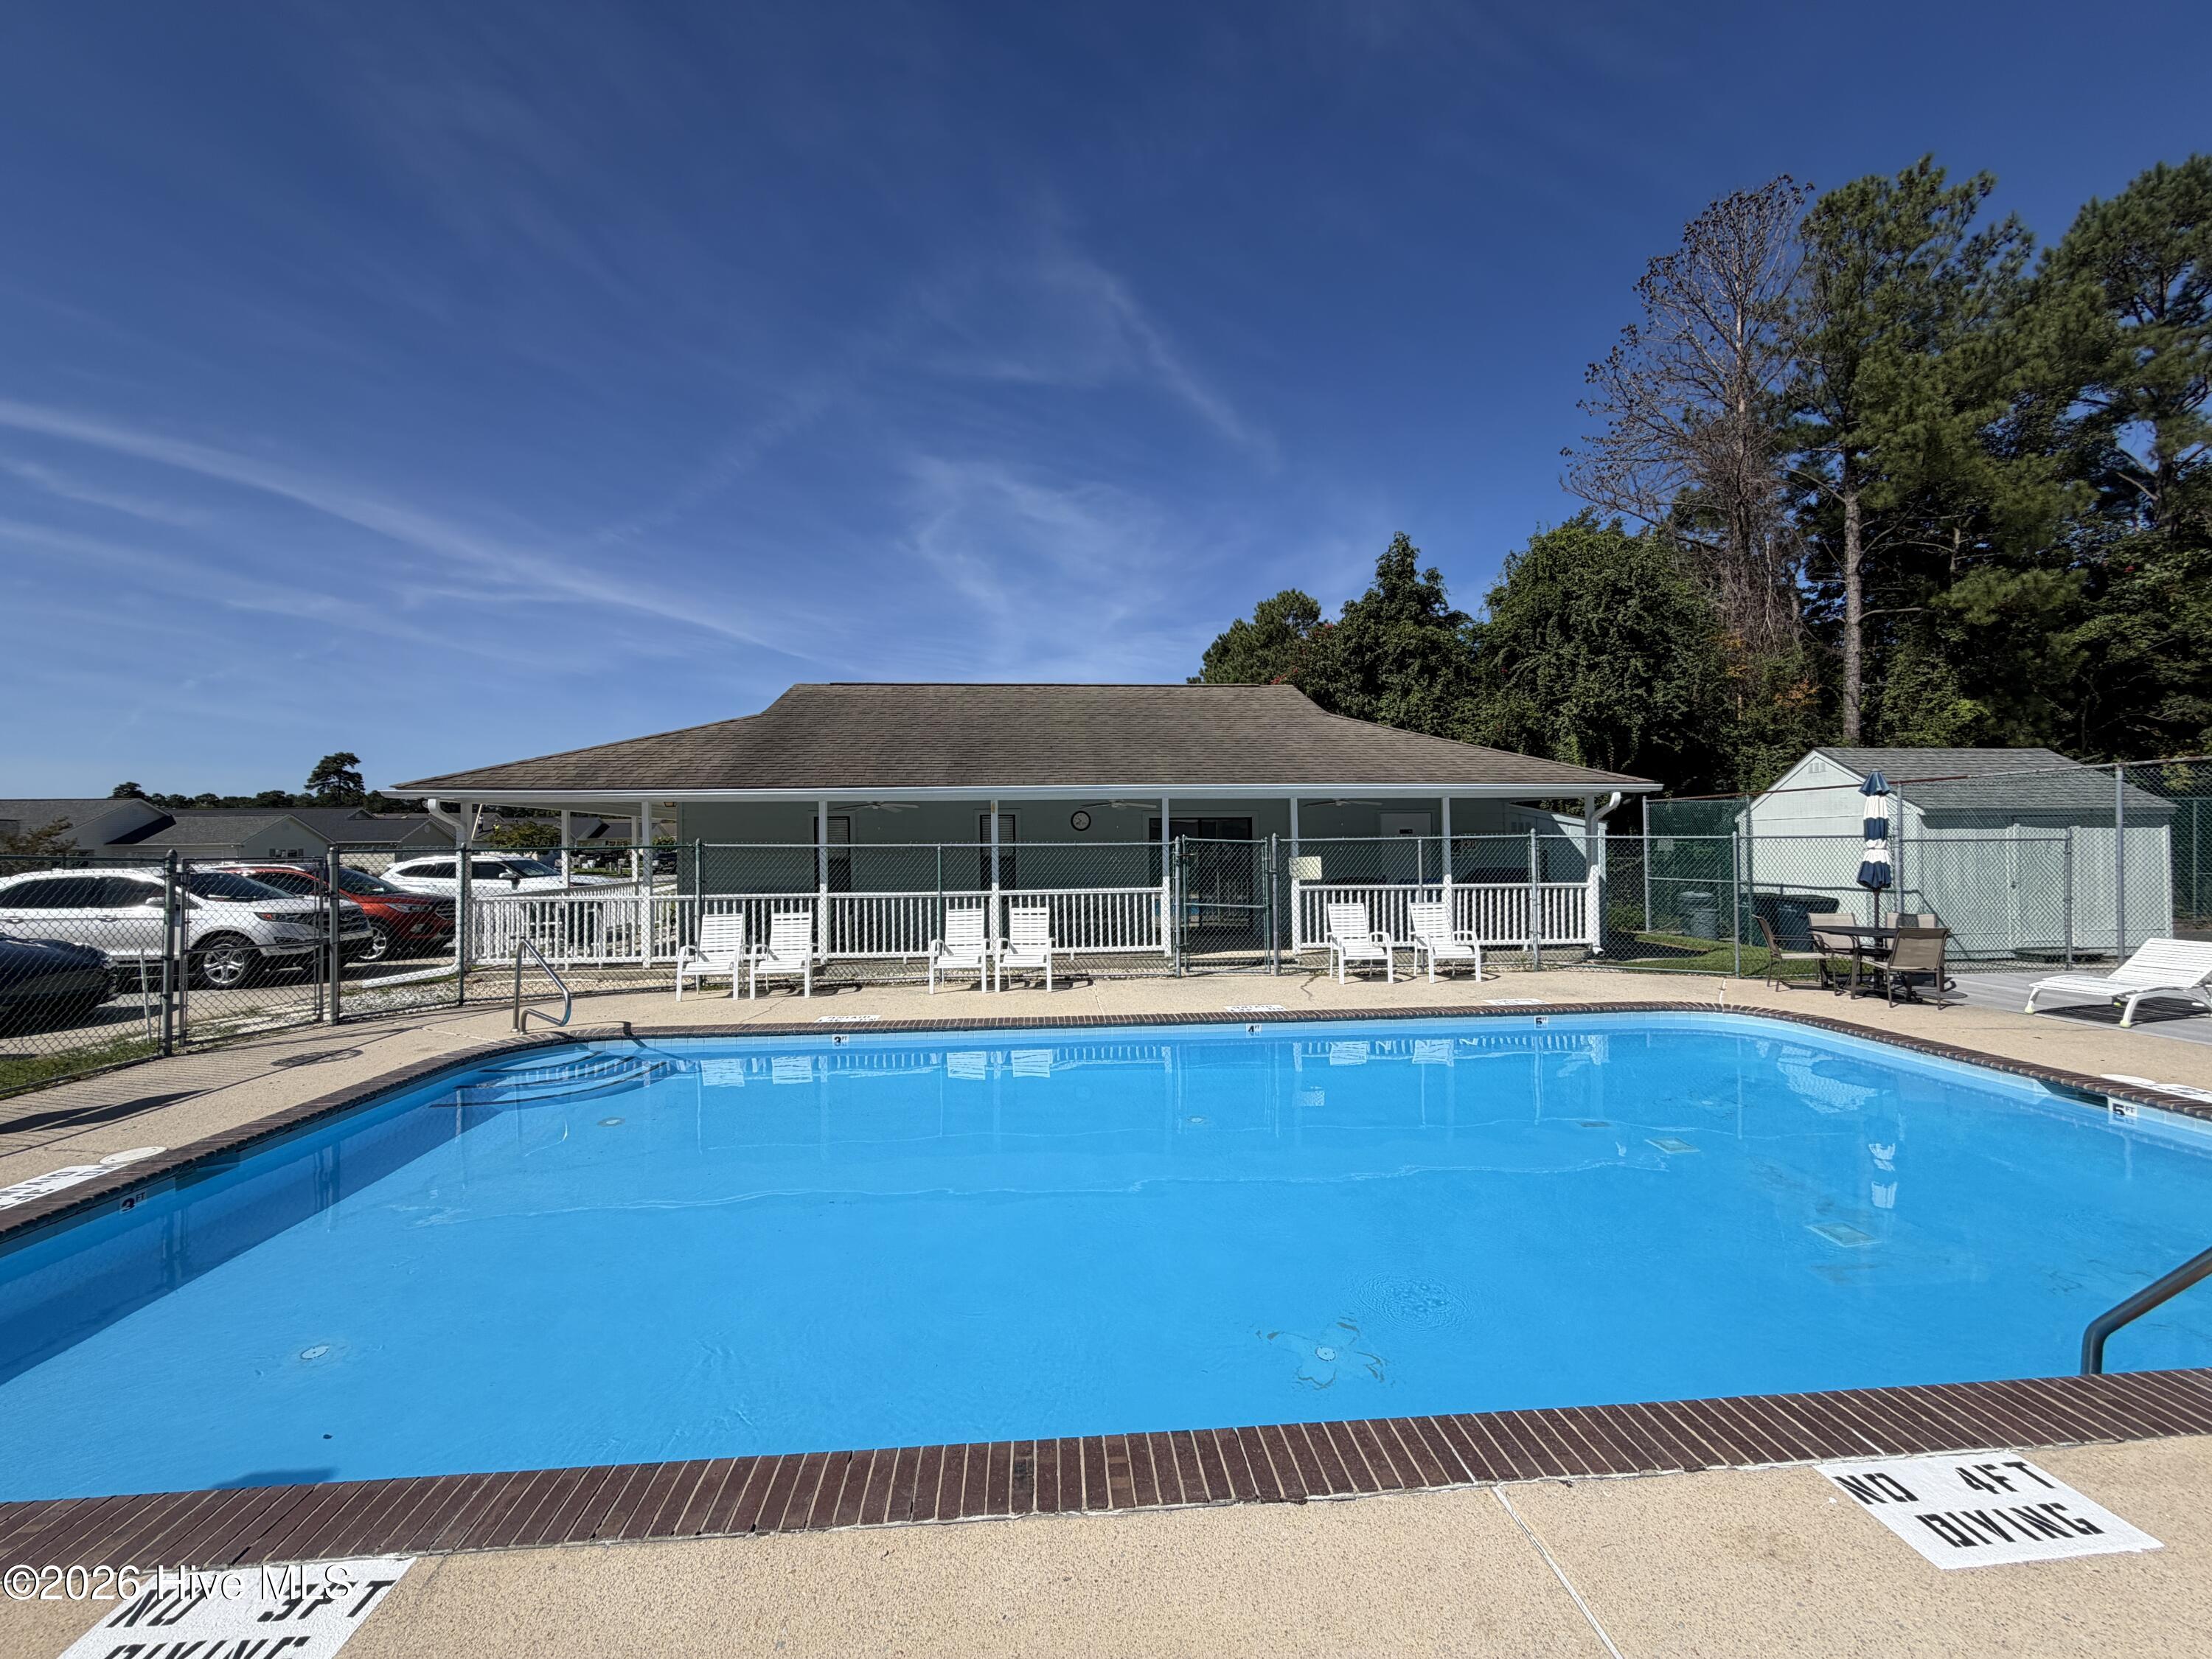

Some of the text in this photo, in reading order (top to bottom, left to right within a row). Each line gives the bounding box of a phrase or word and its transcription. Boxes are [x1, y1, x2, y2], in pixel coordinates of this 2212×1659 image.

[1834, 1461, 2056, 1506] NO 4FT
[1915, 1503, 2106, 1548] DIVING
